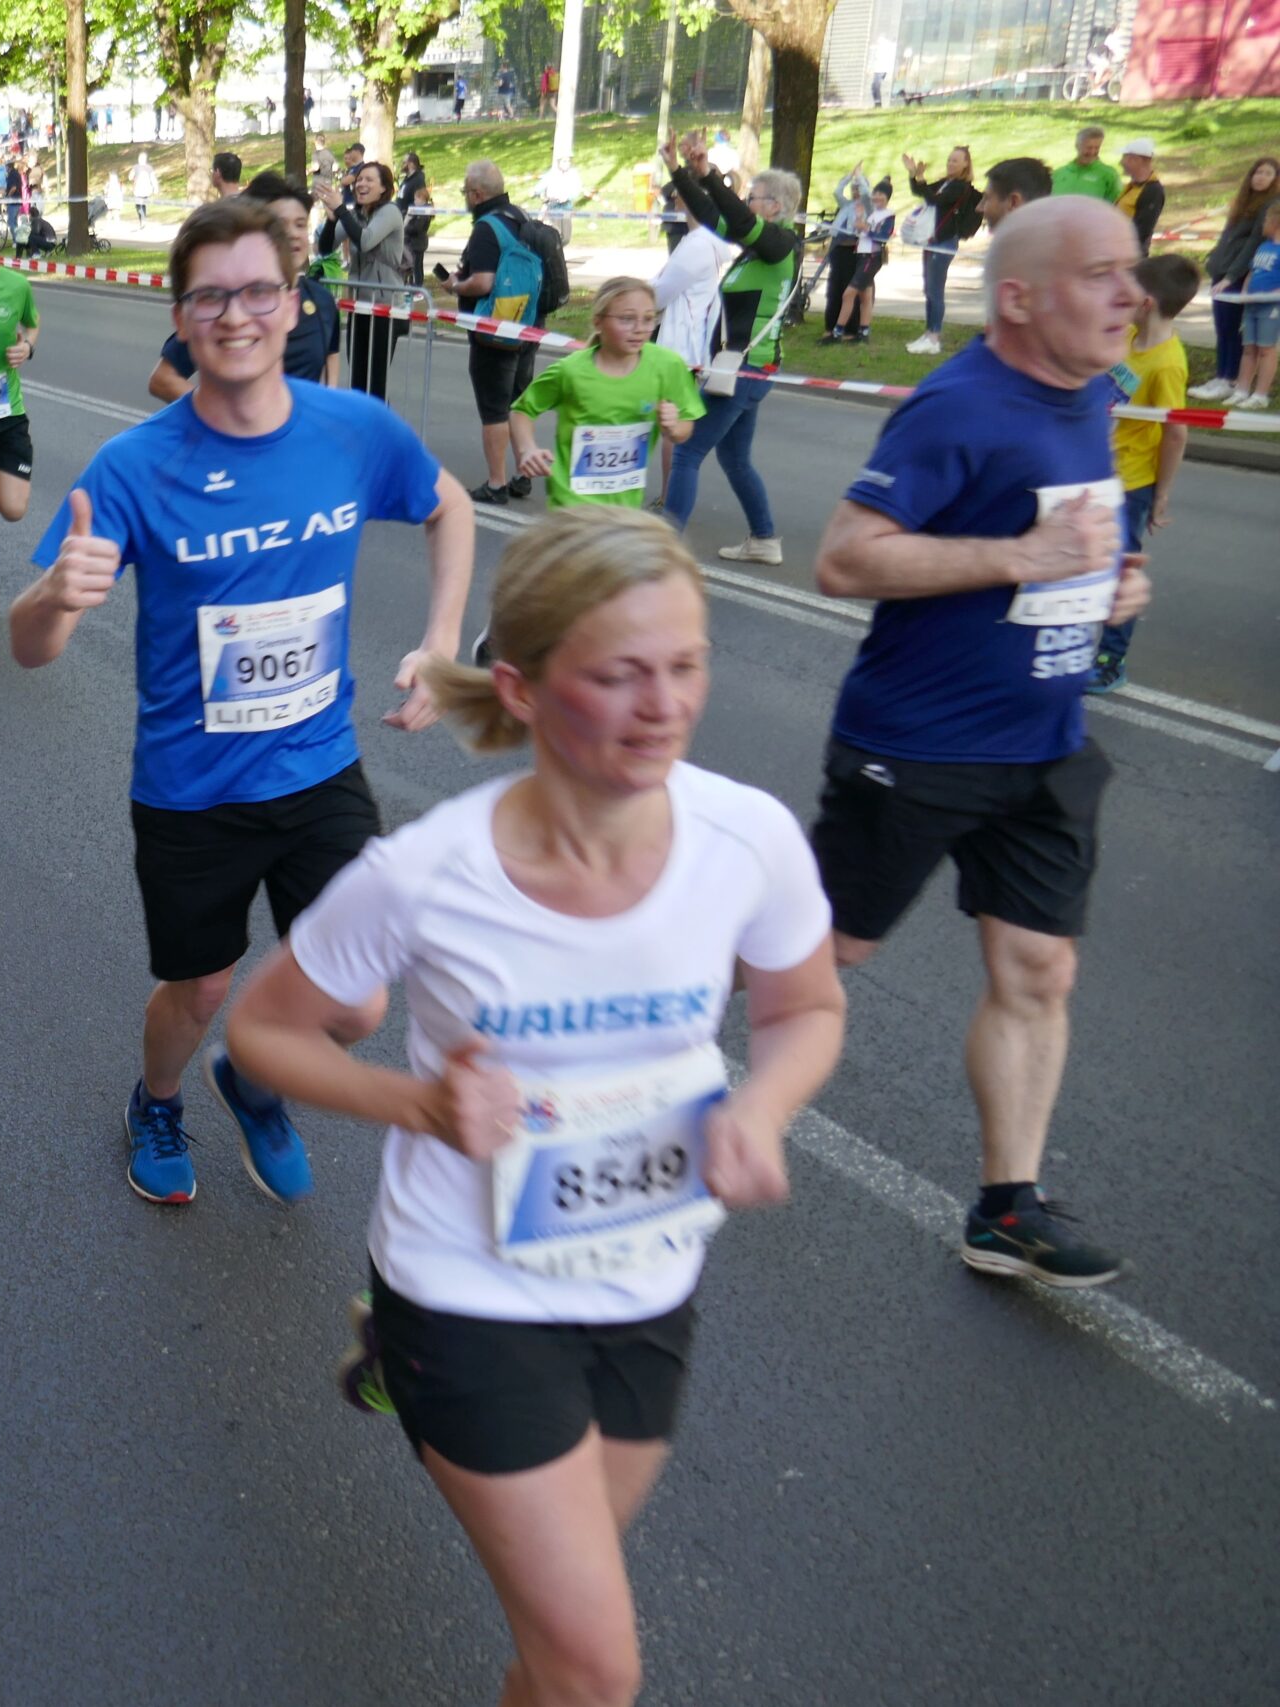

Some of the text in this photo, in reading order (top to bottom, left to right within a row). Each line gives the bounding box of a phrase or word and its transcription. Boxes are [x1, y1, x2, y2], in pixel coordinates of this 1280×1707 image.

[584, 450, 639, 468] 13244
[176, 501, 358, 563] LINZ AG
[237, 642, 319, 684] 9067
[213, 703, 292, 725] LINZ
[297, 686, 331, 714] AG
[552, 1142, 687, 1213] 8549
